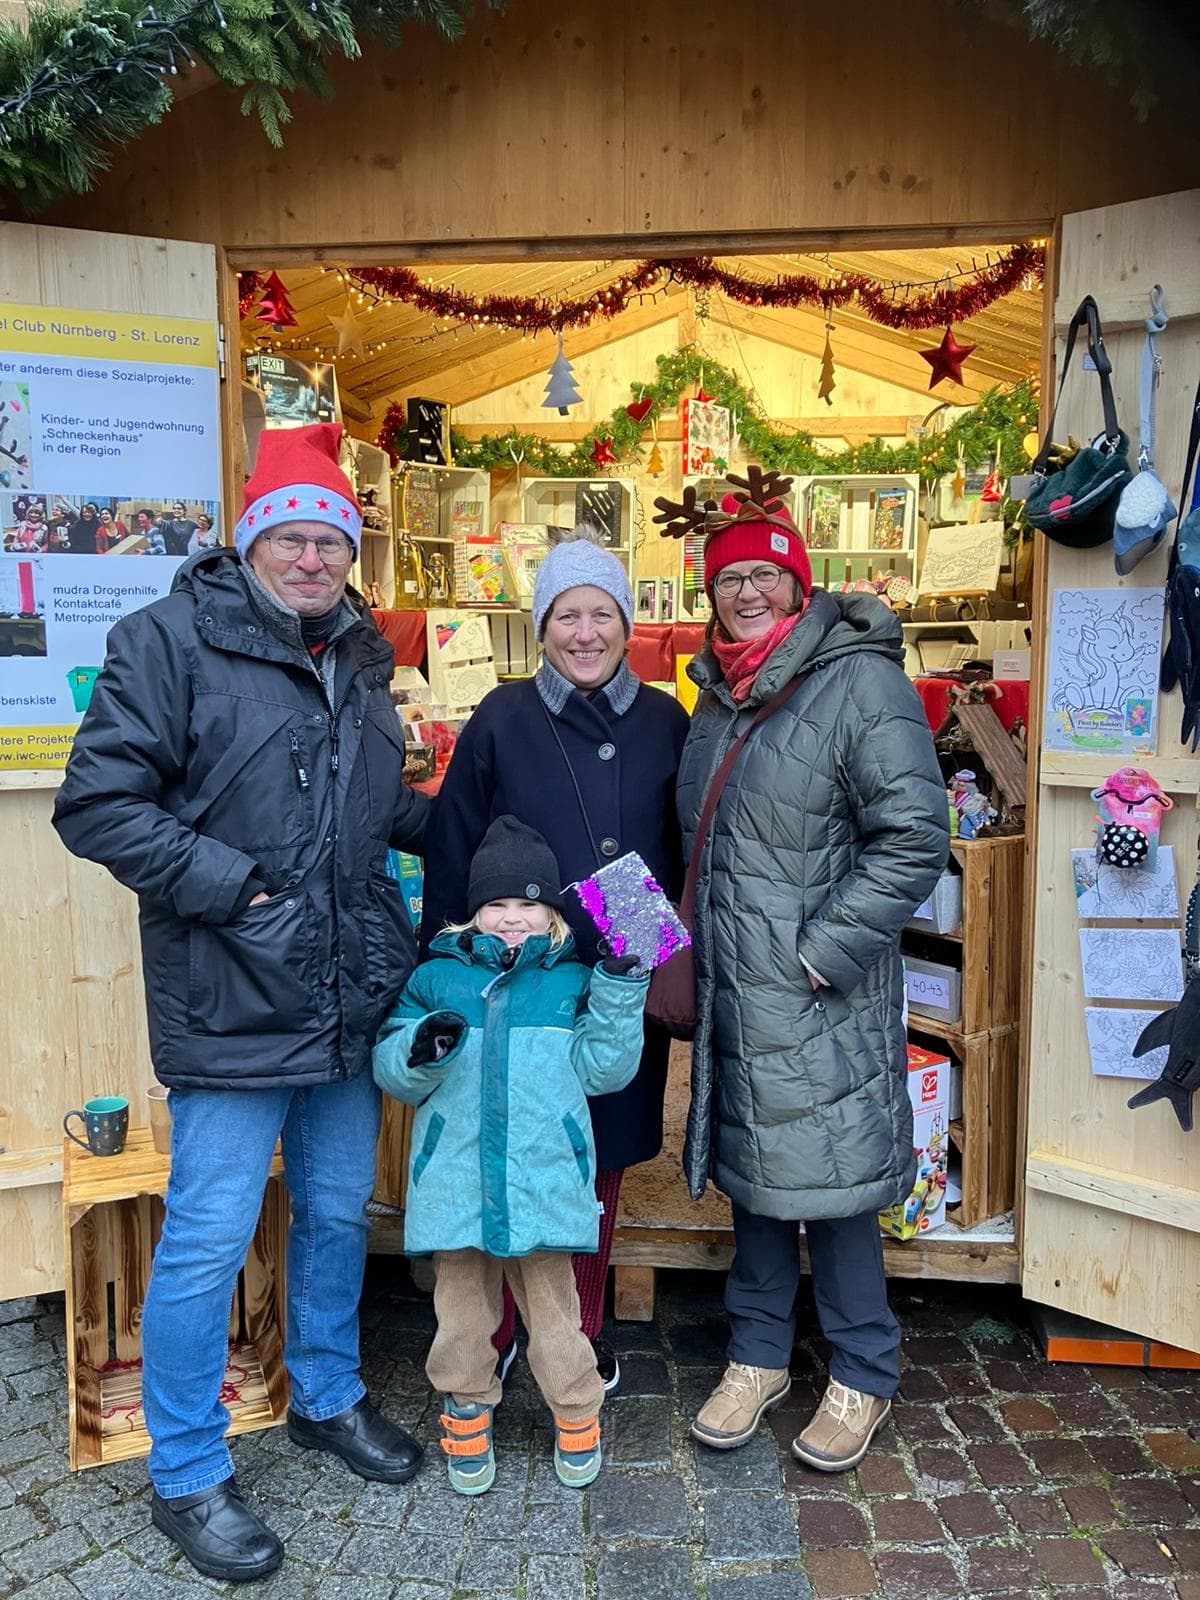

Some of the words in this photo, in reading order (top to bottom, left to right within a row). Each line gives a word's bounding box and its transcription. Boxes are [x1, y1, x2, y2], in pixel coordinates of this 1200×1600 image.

[13, 319, 46, 333] Club
[51, 323, 116, 341] Nürnberg
[131, 330, 150, 342] St.
[155, 332, 200, 346] Lorenz
[262, 358, 283, 370] EXIT
[20, 364, 73, 377] anderem
[76, 367, 108, 379] diese
[112, 370, 195, 386] Sozialprojekte:
[41, 413, 85, 426] Kinder-
[88, 415, 110, 428] und
[113, 417, 205, 434] Jugendwohnung
[42, 428, 144, 443] „Schneckenhaus“
[42, 442, 54, 453] in
[57, 443, 76, 454] der
[81, 444, 121, 457] Region
[53, 584, 89, 595] mudra
[94, 585, 158, 597] Drogenhilfe
[54, 598, 122, 609] Kontaktcafé
[55, 612, 125, 624] Metropolre
[0, 694, 57, 705] benskiste
[27, 734, 75, 746] Projekte
[912, 979, 943, 997] 40-43
